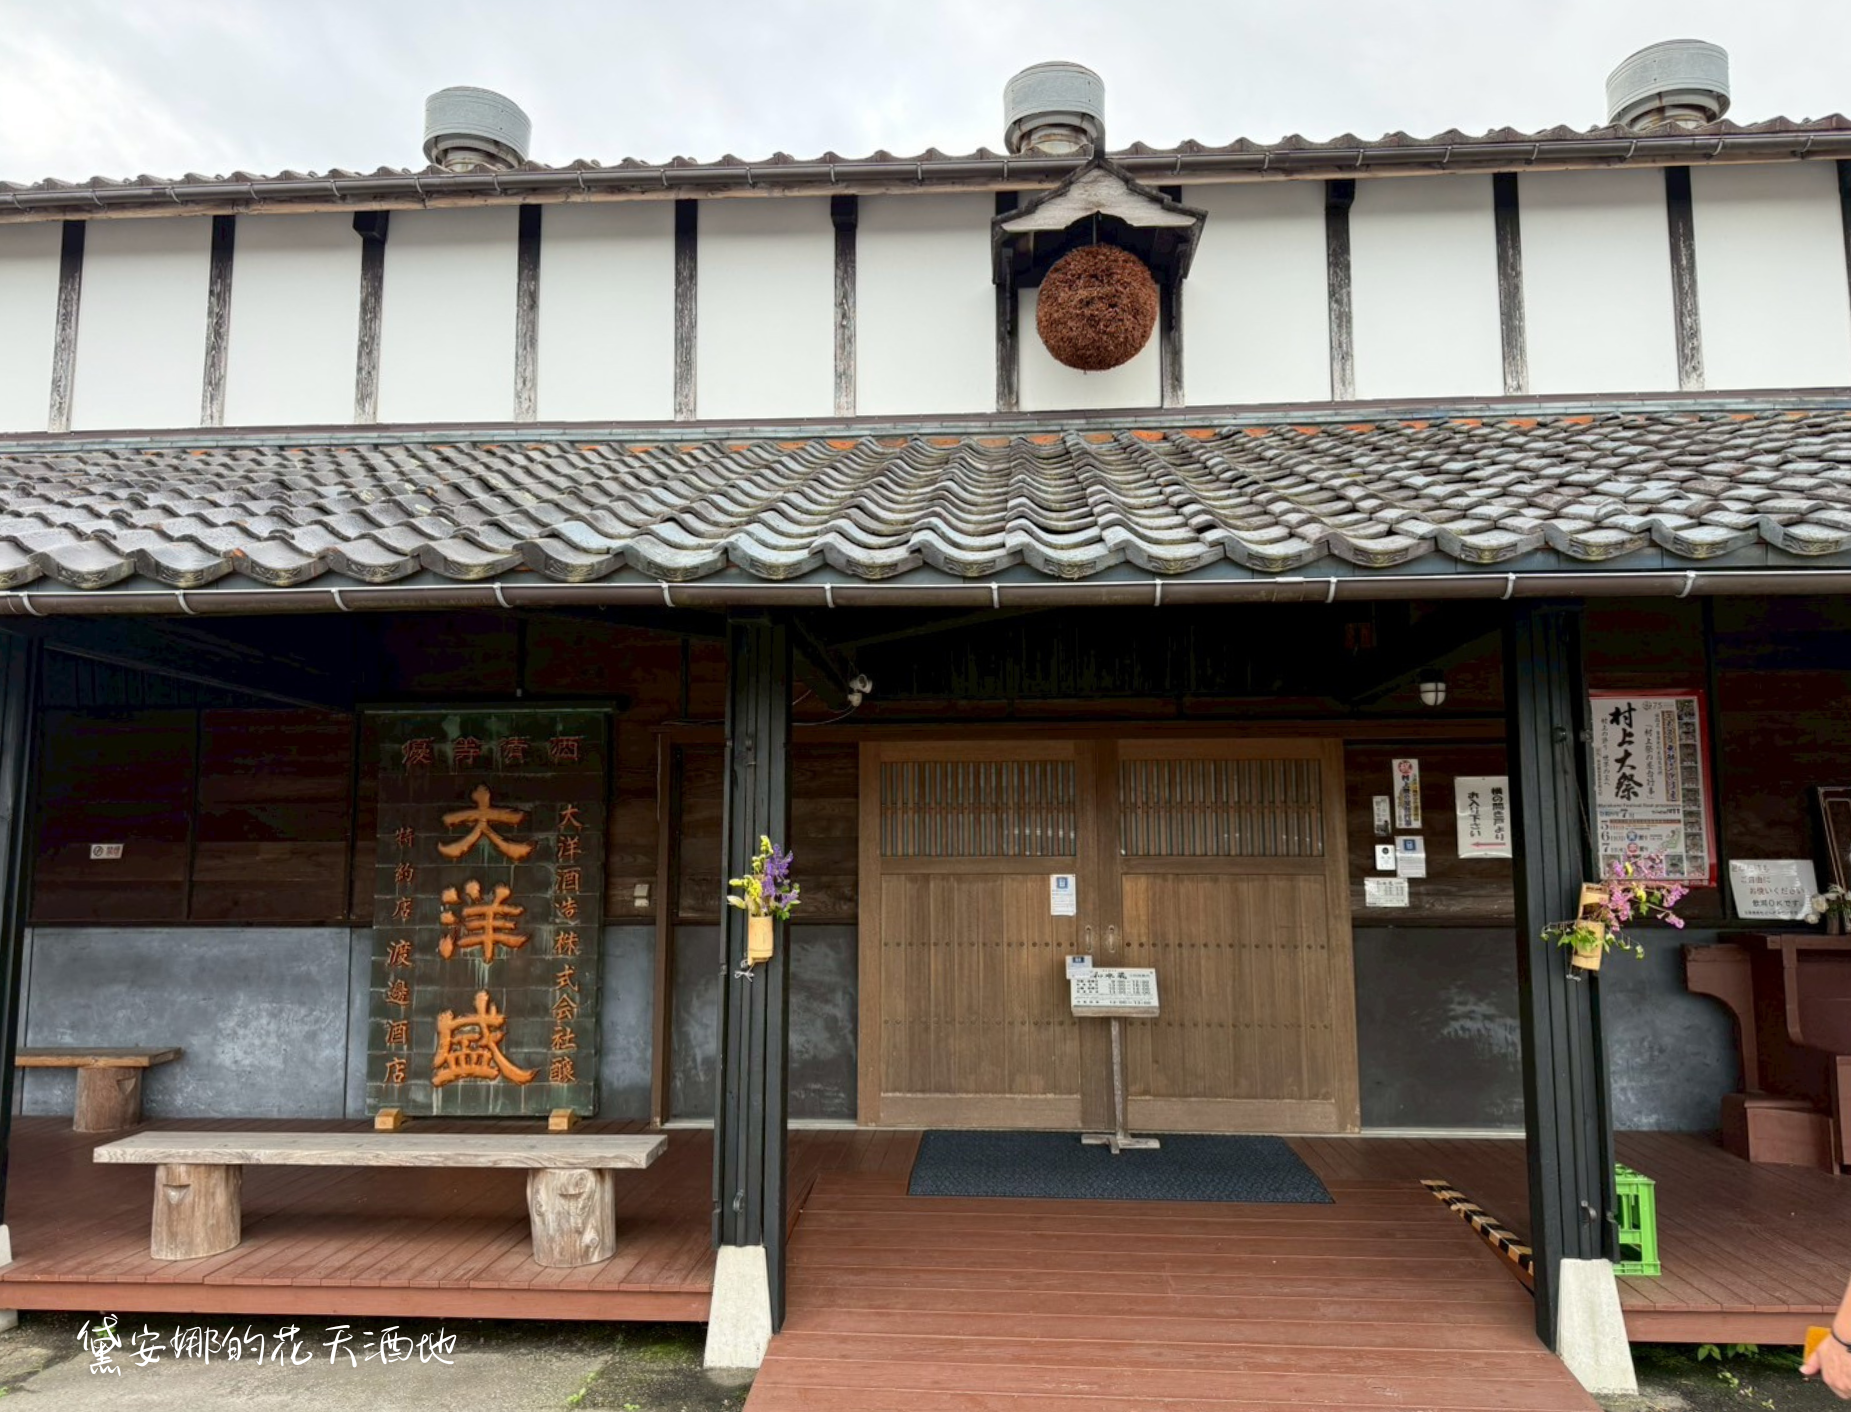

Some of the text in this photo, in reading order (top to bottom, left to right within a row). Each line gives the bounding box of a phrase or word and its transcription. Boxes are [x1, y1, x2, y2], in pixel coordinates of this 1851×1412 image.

[1609, 702, 1643, 801] 村上大祭
[1468, 791, 1481, 837] お入り下さい
[391, 826, 415, 920] 特約店
[431, 783, 538, 1087] 大洋盛
